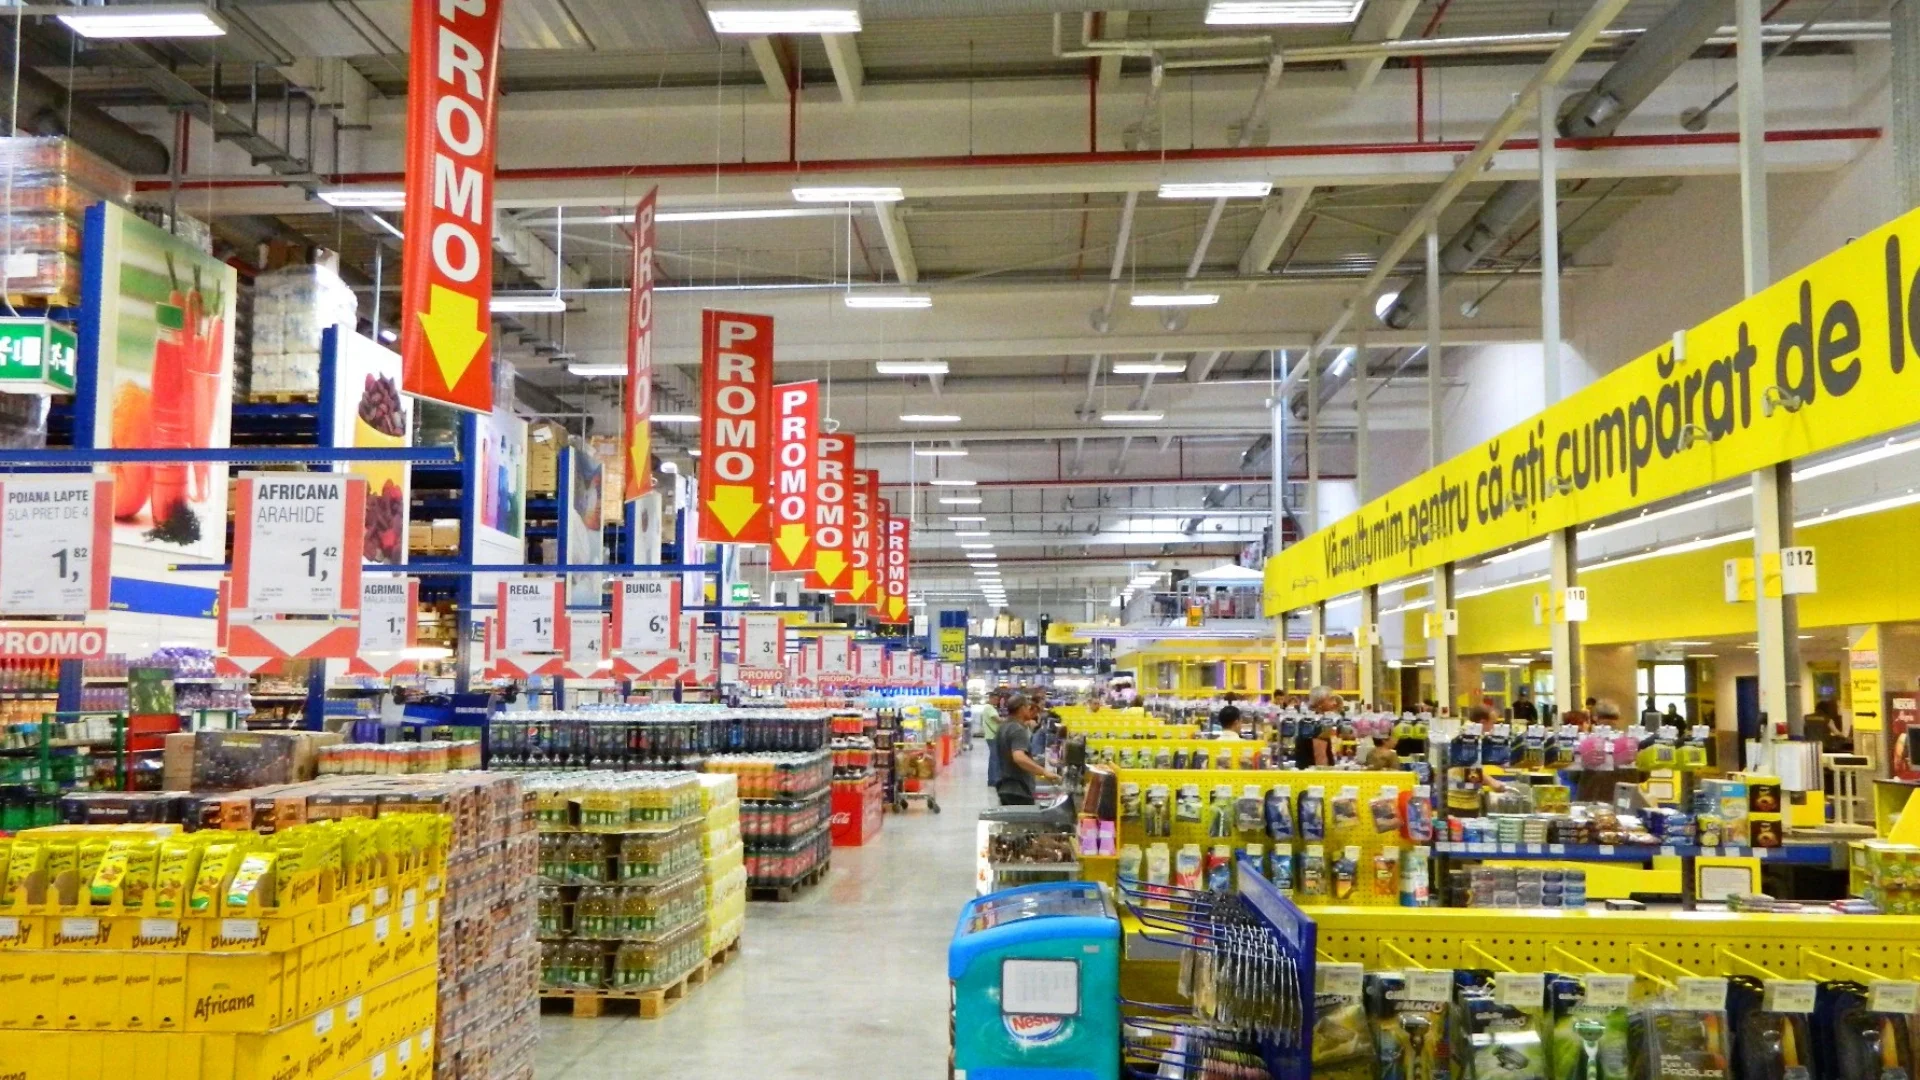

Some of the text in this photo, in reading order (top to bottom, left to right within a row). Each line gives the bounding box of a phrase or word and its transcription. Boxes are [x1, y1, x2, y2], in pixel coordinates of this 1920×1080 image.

[634, 203, 652, 416] PROMO
[714, 320, 757, 481] PROMO
[1408, 474, 1469, 568] pentru
[1476, 438, 1503, 525] că
[1555, 321, 1758, 497] cumpărat
[1775, 279, 1862, 413] de
[780, 389, 808, 521] PROMO
[8, 489, 89, 503] POIANA LAPTE
[258, 484, 339, 501] AFRICANA
[815, 437, 845, 548] PROMO
[31, 507, 60, 521] PRET
[63, 506, 79, 519] DE
[81, 506, 89, 518] 4
[256, 505, 326, 523] ARAHIDE
[888, 520, 906, 595] PROMO
[1796, 550, 1814, 566] 12
[364, 584, 405, 595] AGRIMIL
[509, 584, 541, 595] REGAL
[625, 583, 663, 594] BUNICA
[740, 670, 783, 679] PROMO
[193, 992, 256, 1023] Africana
